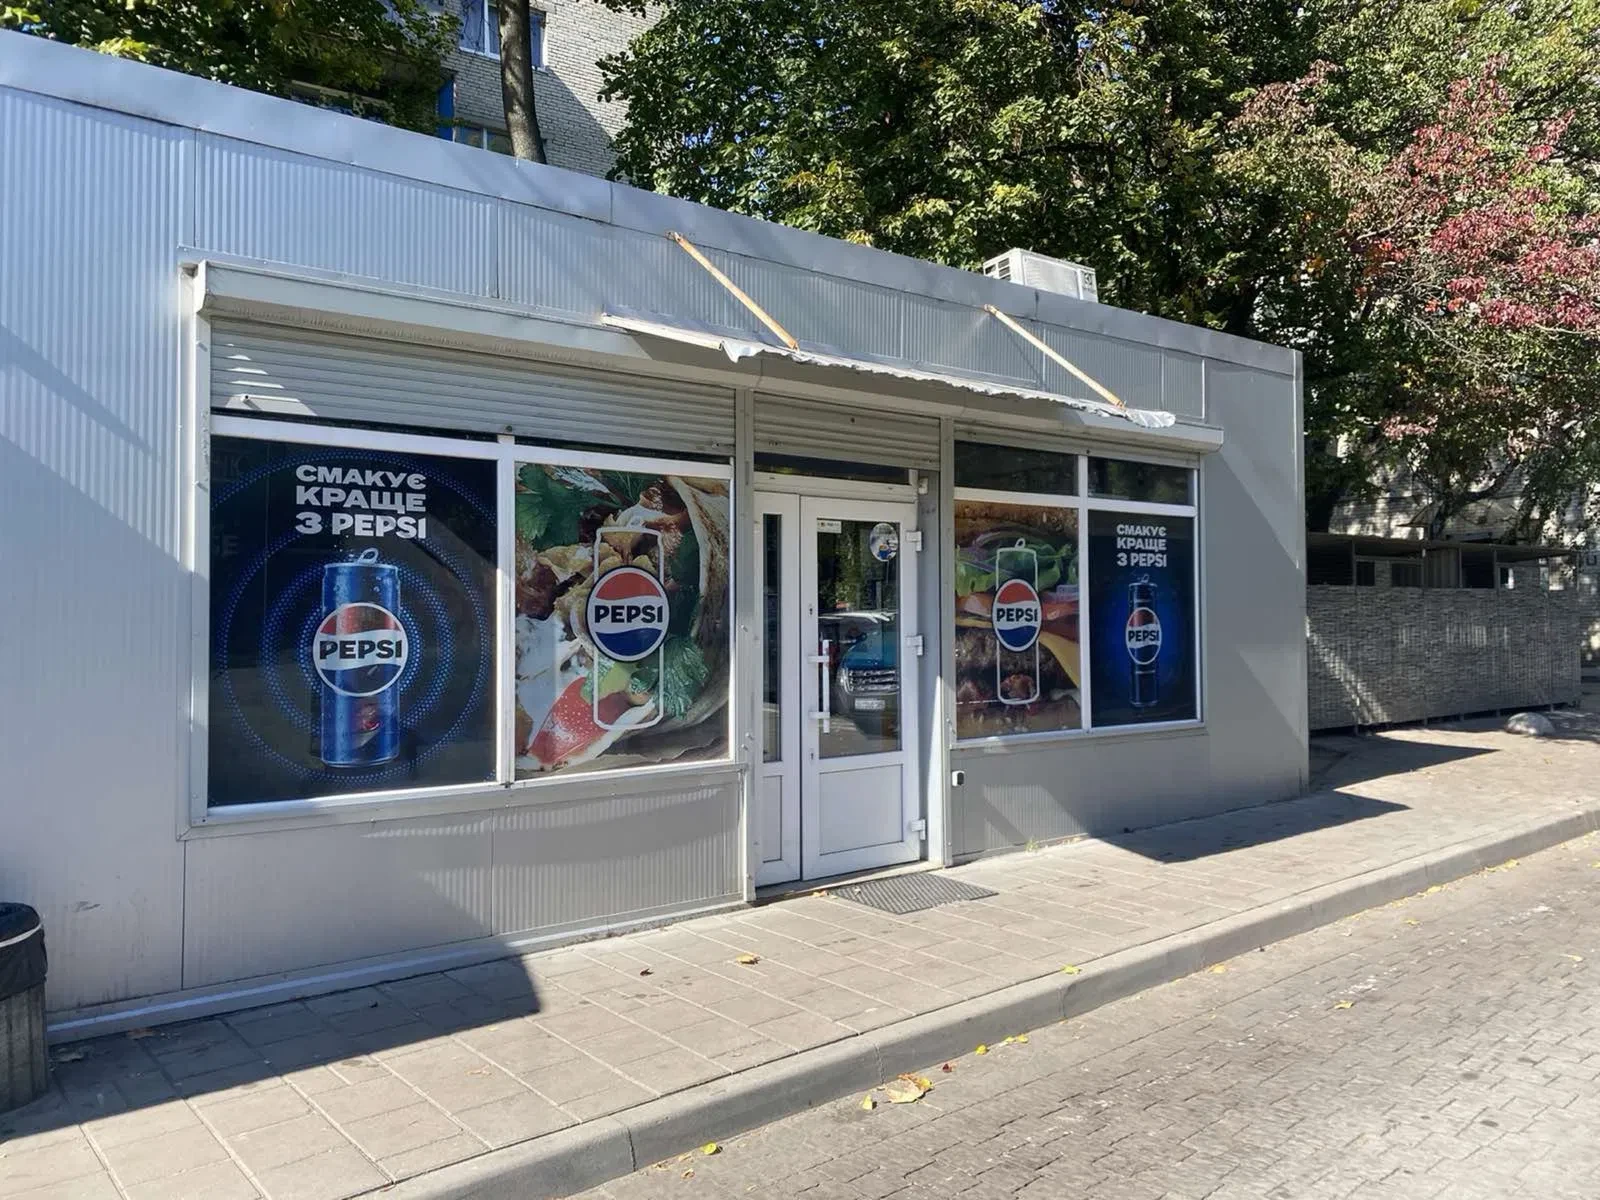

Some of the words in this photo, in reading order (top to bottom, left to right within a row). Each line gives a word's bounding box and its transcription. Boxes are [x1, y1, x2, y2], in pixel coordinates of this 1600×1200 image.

[296, 465, 426, 490] СМАКУЄ
[296, 485, 426, 514] КРАЩЕ
[295, 512, 323, 534] З
[332, 512, 426, 539] PEPSI
[1116, 524, 1167, 537] СМАКУЄ
[1116, 537, 1167, 552] КРАЩЕ
[1116, 552, 1128, 567] З
[1130, 552, 1167, 567] PEPSI
[594, 605, 663, 623] PEPSI
[996, 607, 1038, 622] PEPSI
[1128, 630, 1160, 642] PEPSI
[319, 639, 402, 659] PEPSI
